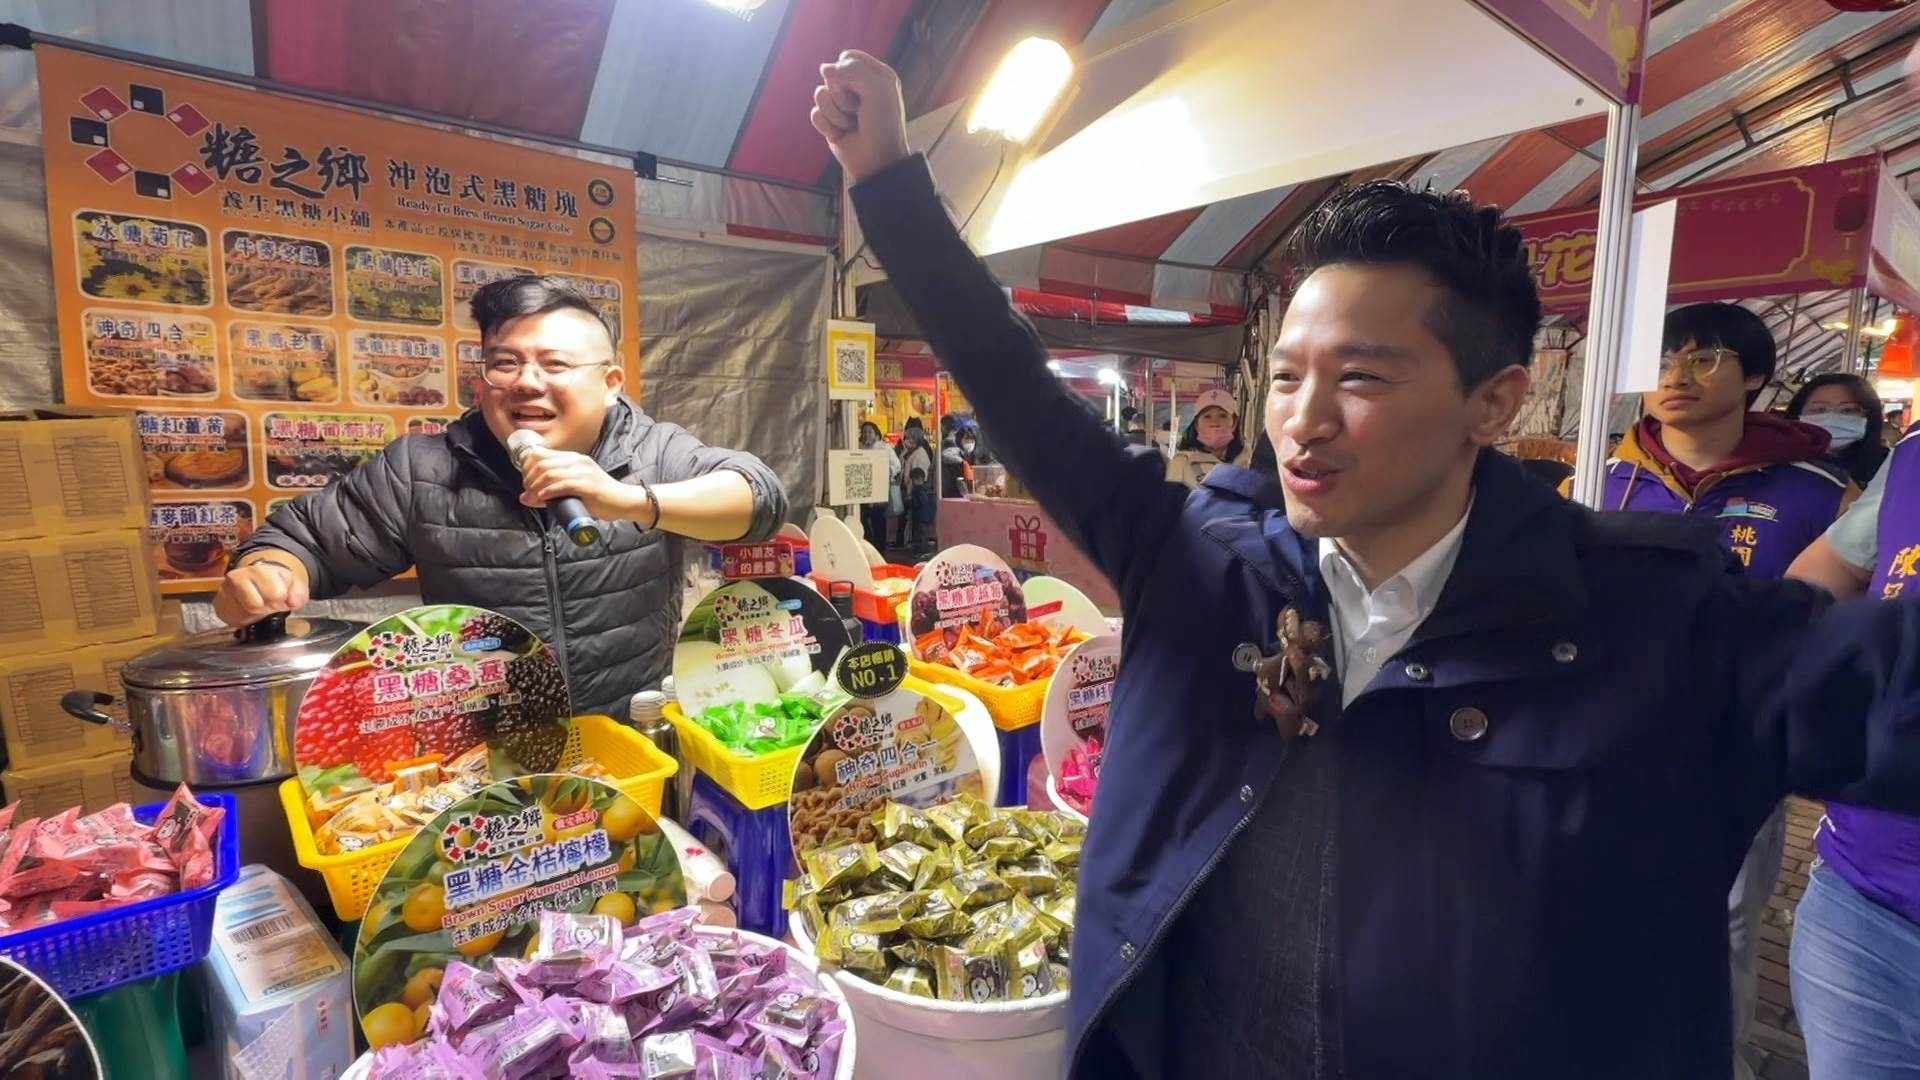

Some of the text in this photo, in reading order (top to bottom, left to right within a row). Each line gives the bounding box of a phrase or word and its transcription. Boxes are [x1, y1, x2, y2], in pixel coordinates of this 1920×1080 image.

[199, 122, 370, 201] 糖之鄉
[387, 158, 579, 219] 沖泡式黑糖塊
[93, 218, 194, 249] 冰糖菊花
[95, 319, 209, 341] 神奇四合一
[271, 417, 386, 440] 黑糖葡萄籽
[739, 546, 776, 559] 小朋友
[740, 561, 776, 575] 的最愛
[720, 616, 807, 648] 黑糖冬瓜
[851, 663, 899, 690] NO.1
[837, 740, 937, 783] 神奇四合一
[484, 809, 543, 842] 糖之鄉
[446, 830, 610, 907] 黑糖金桔檸檬
[443, 863, 619, 927] Brown Sugar Kumquat Lemon
